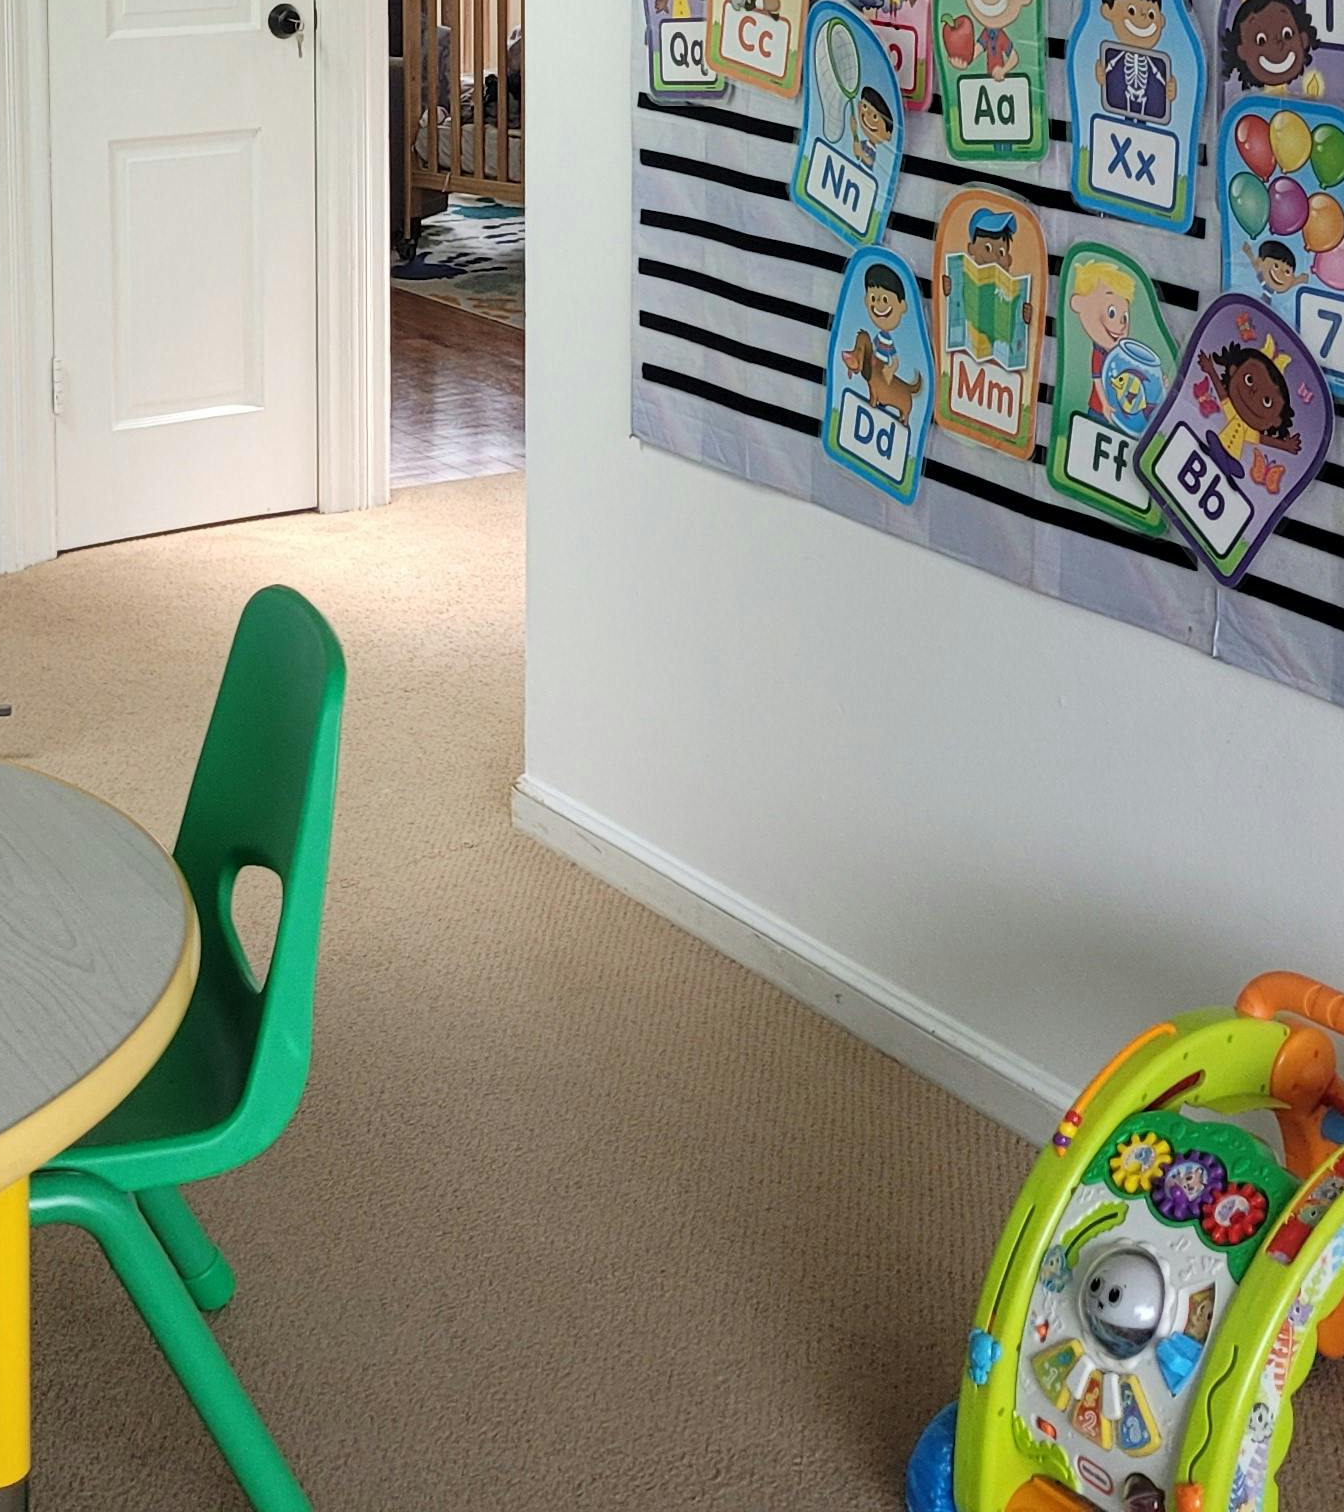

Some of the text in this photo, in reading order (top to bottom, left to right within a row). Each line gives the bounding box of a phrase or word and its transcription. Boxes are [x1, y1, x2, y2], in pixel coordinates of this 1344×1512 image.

[669, 31, 709, 77] Qq
[738, 15, 774, 58] Cc
[974, 84, 1015, 126] Aa
[821, 154, 861, 213] Nn
[1107, 133, 1156, 186] Xx
[1317, 308, 1343, 359] 7
[957, 360, 1014, 418] Mm
[853, 404, 896, 461] Dd
[1092, 431, 1130, 482] Ff
[1177, 449, 1226, 521] Bb
